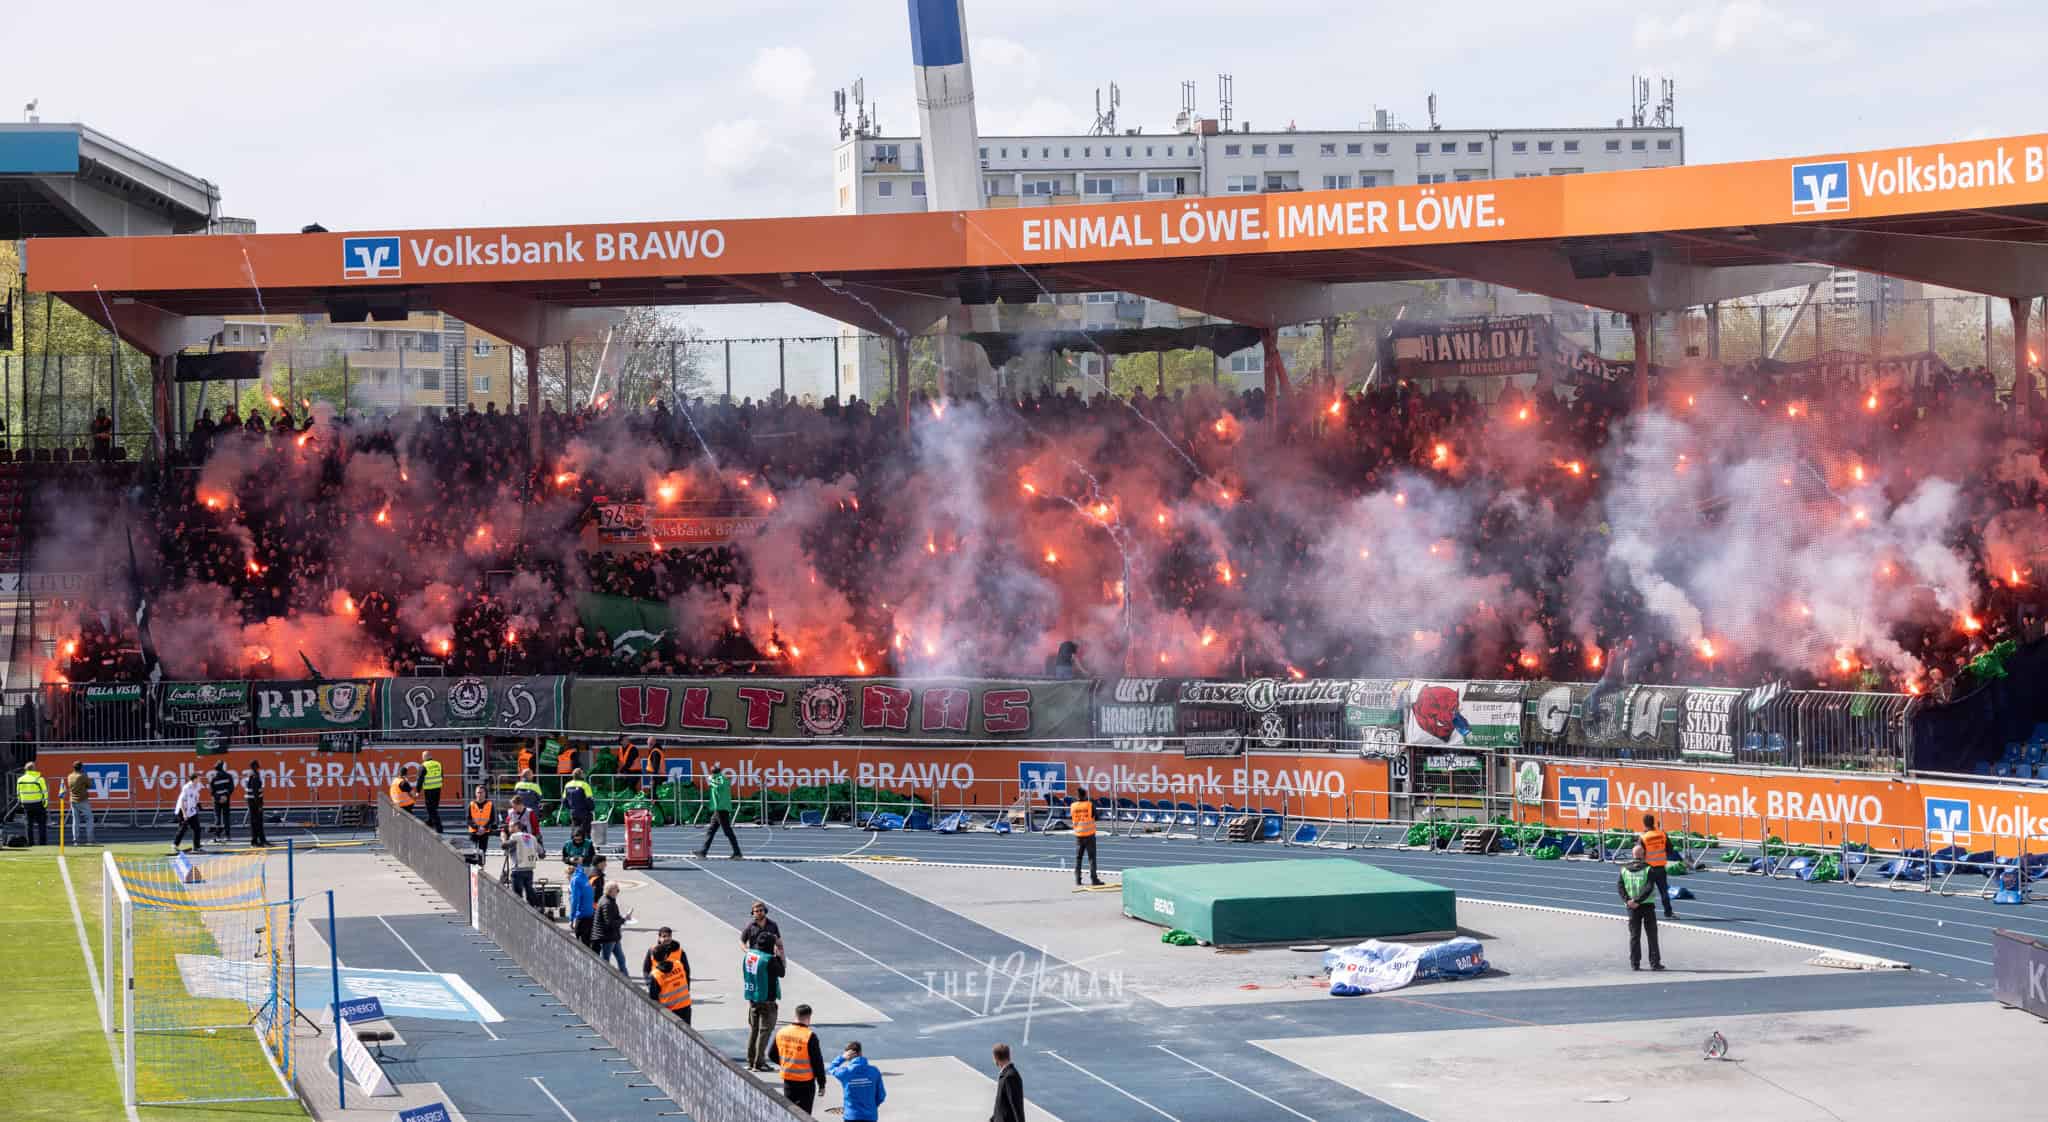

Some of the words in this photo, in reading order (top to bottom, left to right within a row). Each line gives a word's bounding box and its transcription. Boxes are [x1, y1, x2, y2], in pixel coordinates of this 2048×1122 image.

[1857, 147, 2015, 197] Volksbank
[2025, 146, 2048, 183] B
[1023, 214, 1152, 251] EINMAL
[1161, 202, 1270, 245] LÖWE.
[1278, 200, 1389, 239] IMMER
[1398, 188, 1505, 232] LÖWE.
[410, 232, 584, 267] Volksbank
[596, 229, 725, 261] BRAWO
[88, 686, 114, 696] BELLA
[116, 685, 141, 695] VISTA
[258, 690, 316, 718] P&P
[1685, 693, 1732, 713] GEGEN
[1263, 721, 1280, 739] 96
[1686, 712, 1729, 734] STADT
[1503, 731, 1519, 744] 96
[465, 746, 483, 766] 19
[1393, 756, 1408, 776] 18
[858, 763, 974, 790] BRAWO
[1075, 764, 1222, 795] Volksbank
[1233, 768, 1345, 798] BRAWO
[1616, 781, 1757, 817] Volksbank
[1767, 790, 1882, 825] BRAWO
